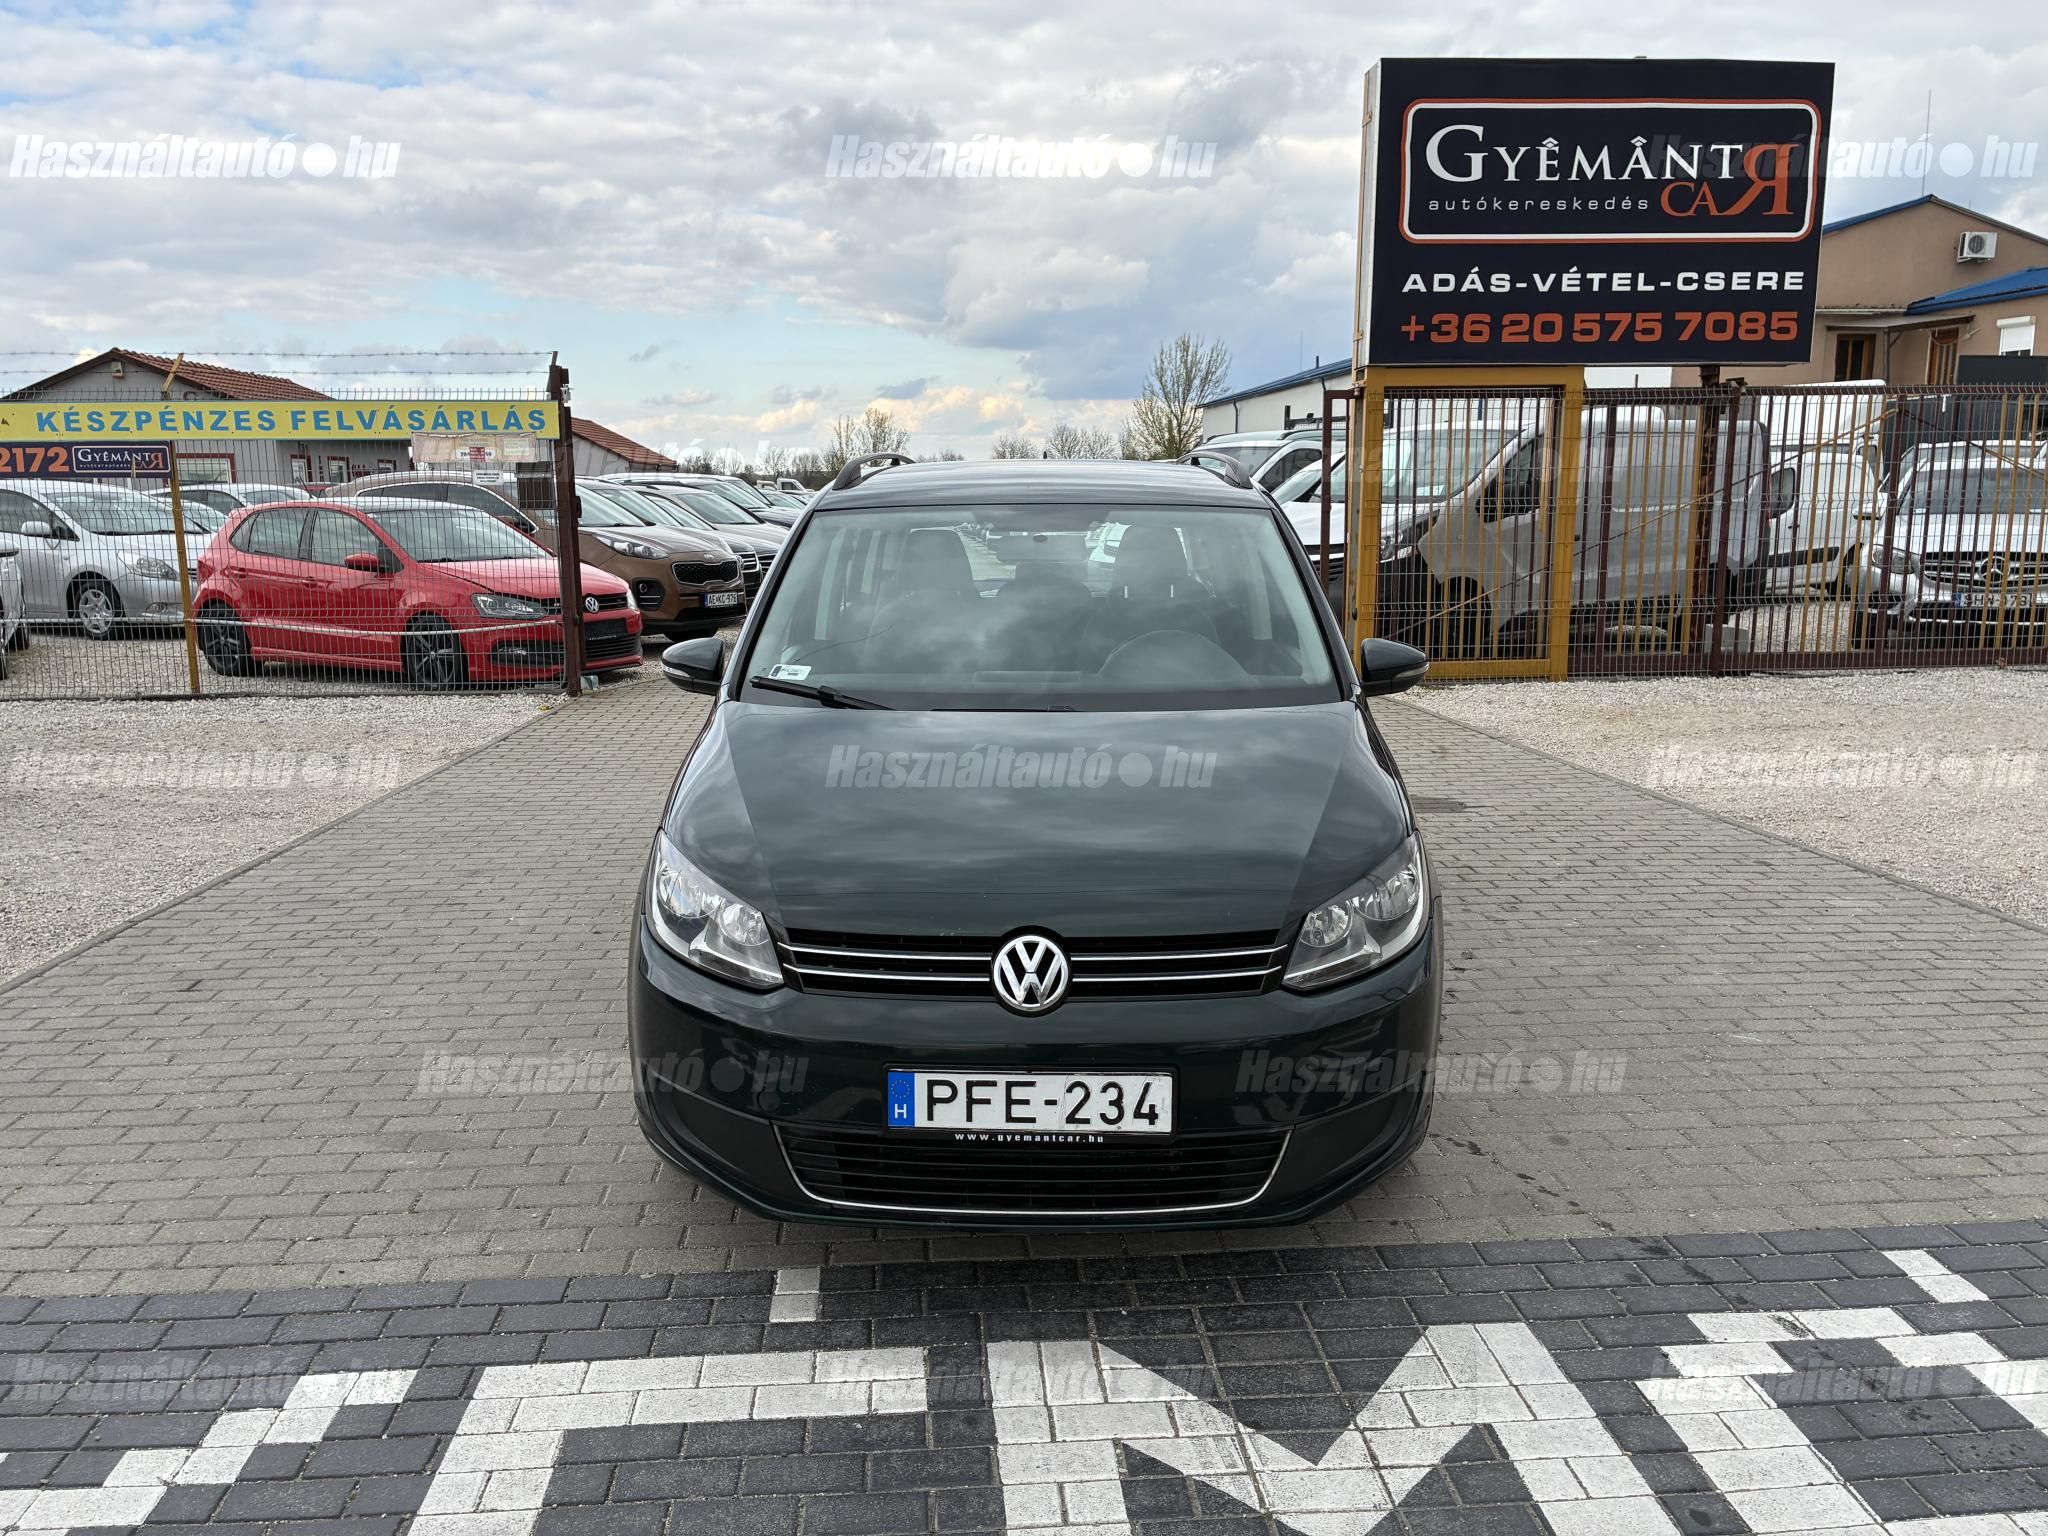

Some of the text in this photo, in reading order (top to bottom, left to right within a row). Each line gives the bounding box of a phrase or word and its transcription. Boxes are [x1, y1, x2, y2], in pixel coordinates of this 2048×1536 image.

[1428, 196, 1648, 211] autókereskedés
[1501, 312, 1563, 343] 20
[1572, 311, 1662, 342] 575
[1675, 310, 1798, 342] 7085
[36, 404, 546, 433] KÉSZPÉNZES FELVÁSÁRLÁS
[926, 1079, 1159, 1126] PFE-234
[955, 1132, 1104, 1143] www.gyemantcar.hu
